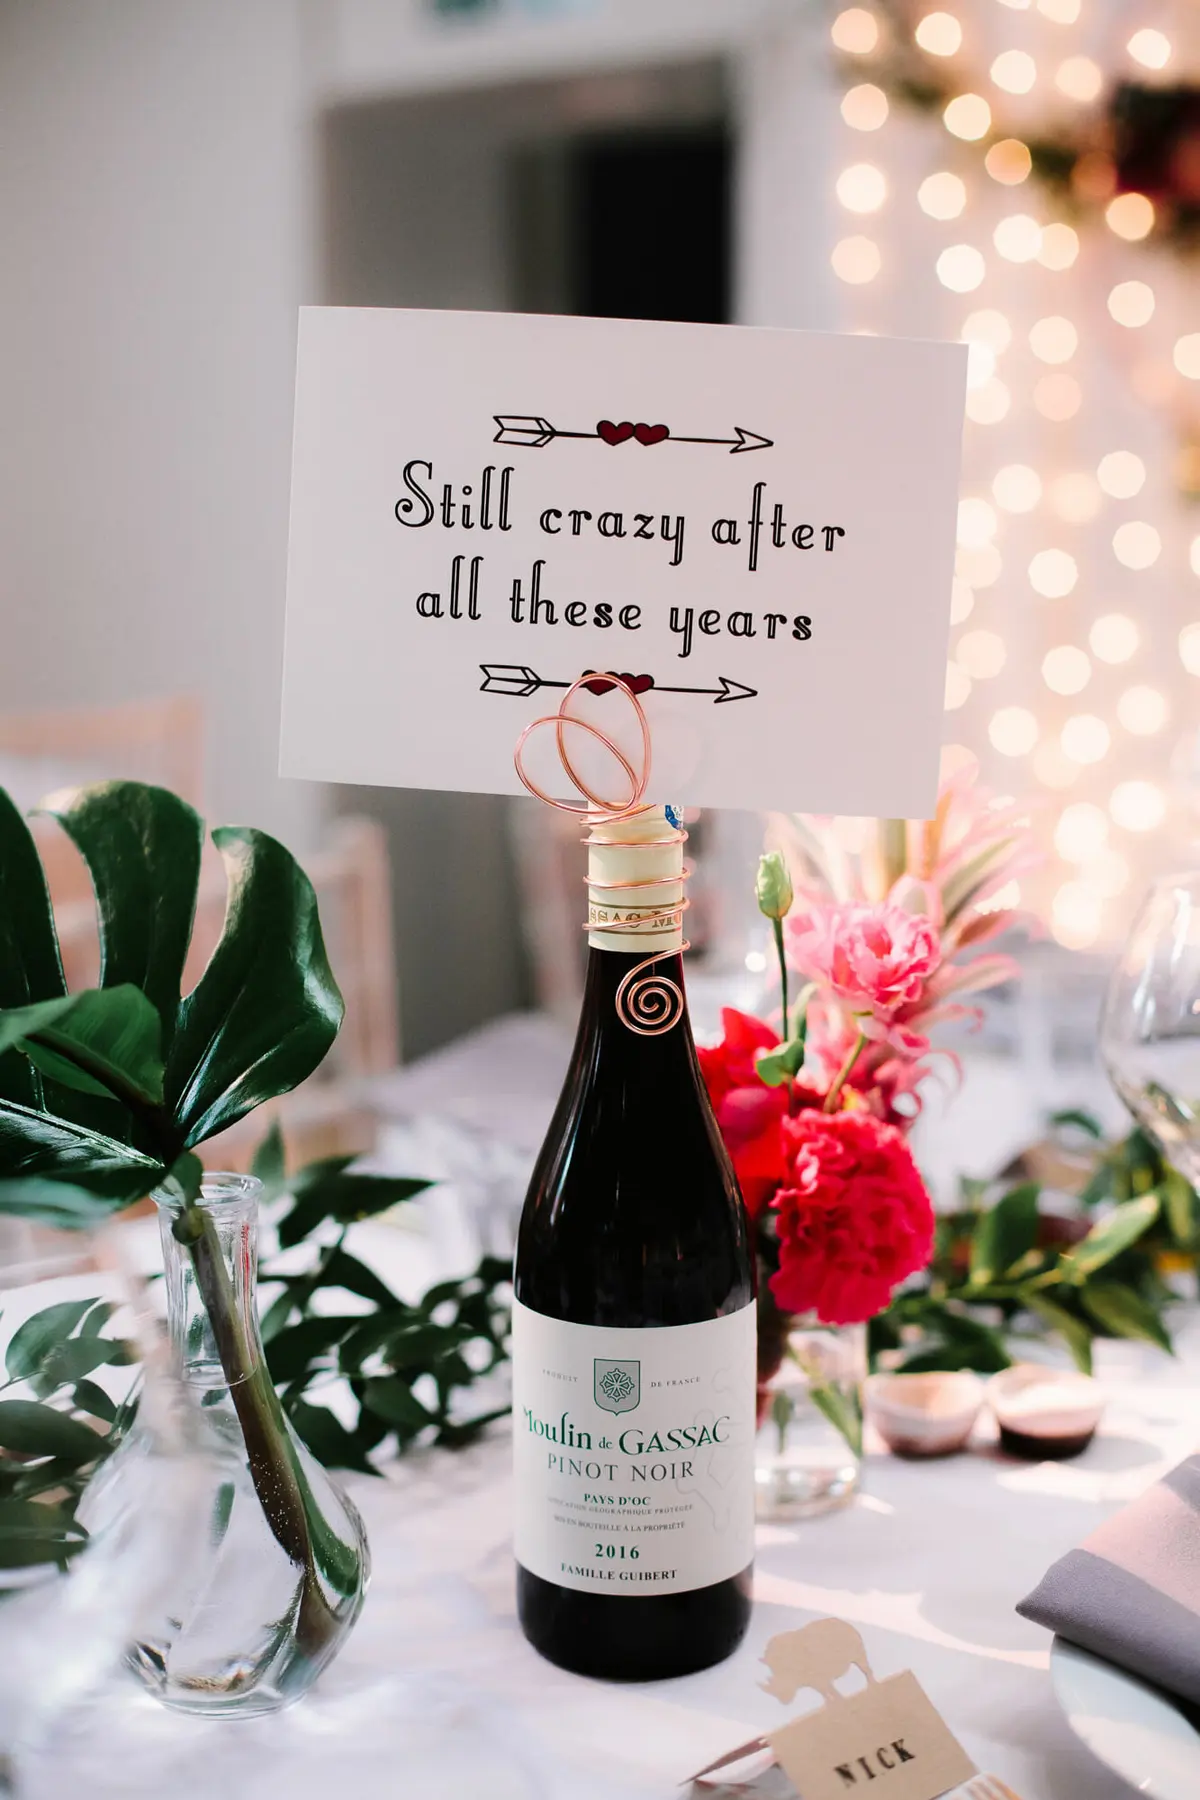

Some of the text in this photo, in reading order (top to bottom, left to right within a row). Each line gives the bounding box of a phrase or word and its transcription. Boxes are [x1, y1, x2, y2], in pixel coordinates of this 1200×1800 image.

[394, 460, 846, 571] Still crazy after
[416, 555, 813, 658] all these years
[650, 1380, 662, 1388] DE
[665, 1375, 701, 1387] FRANCE
[522, 1404, 730, 1456] Moulin de GASSAC
[547, 1452, 694, 1482] PINOT NOIR
[583, 1493, 615, 1505] PAYS
[594, 1543, 640, 1560] 2016
[561, 1562, 678, 1581] FAMILLE GUIBERT
[833, 1738, 915, 1788] NICK
